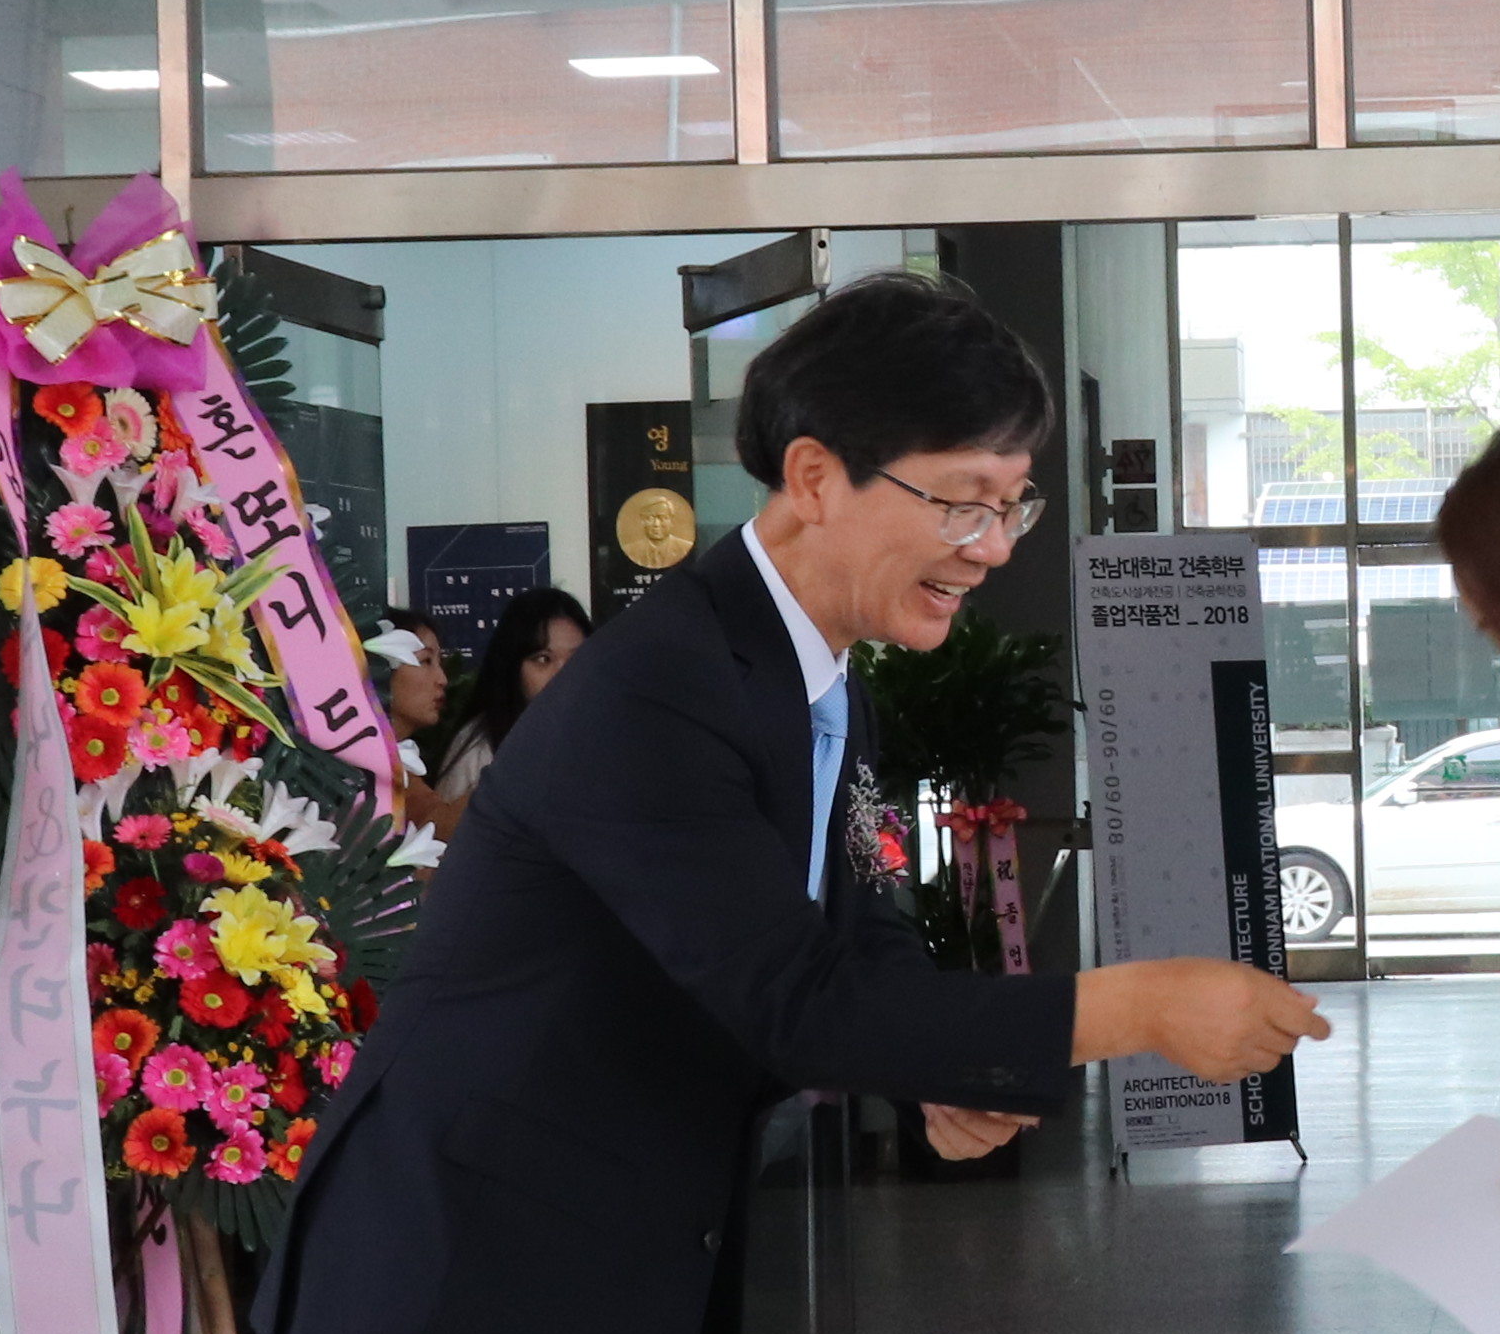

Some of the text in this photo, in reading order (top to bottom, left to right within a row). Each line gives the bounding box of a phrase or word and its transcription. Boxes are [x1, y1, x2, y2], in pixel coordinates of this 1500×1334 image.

[1089, 555, 1247, 580] 전남대학교 건축학부
[1091, 604, 1249, 628] 졸업작품전 2018
[1098, 687, 1125, 847] 09/06-09/08
[1250, 681, 1284, 977] HONNAM NATIONAL UNIVERSITY
